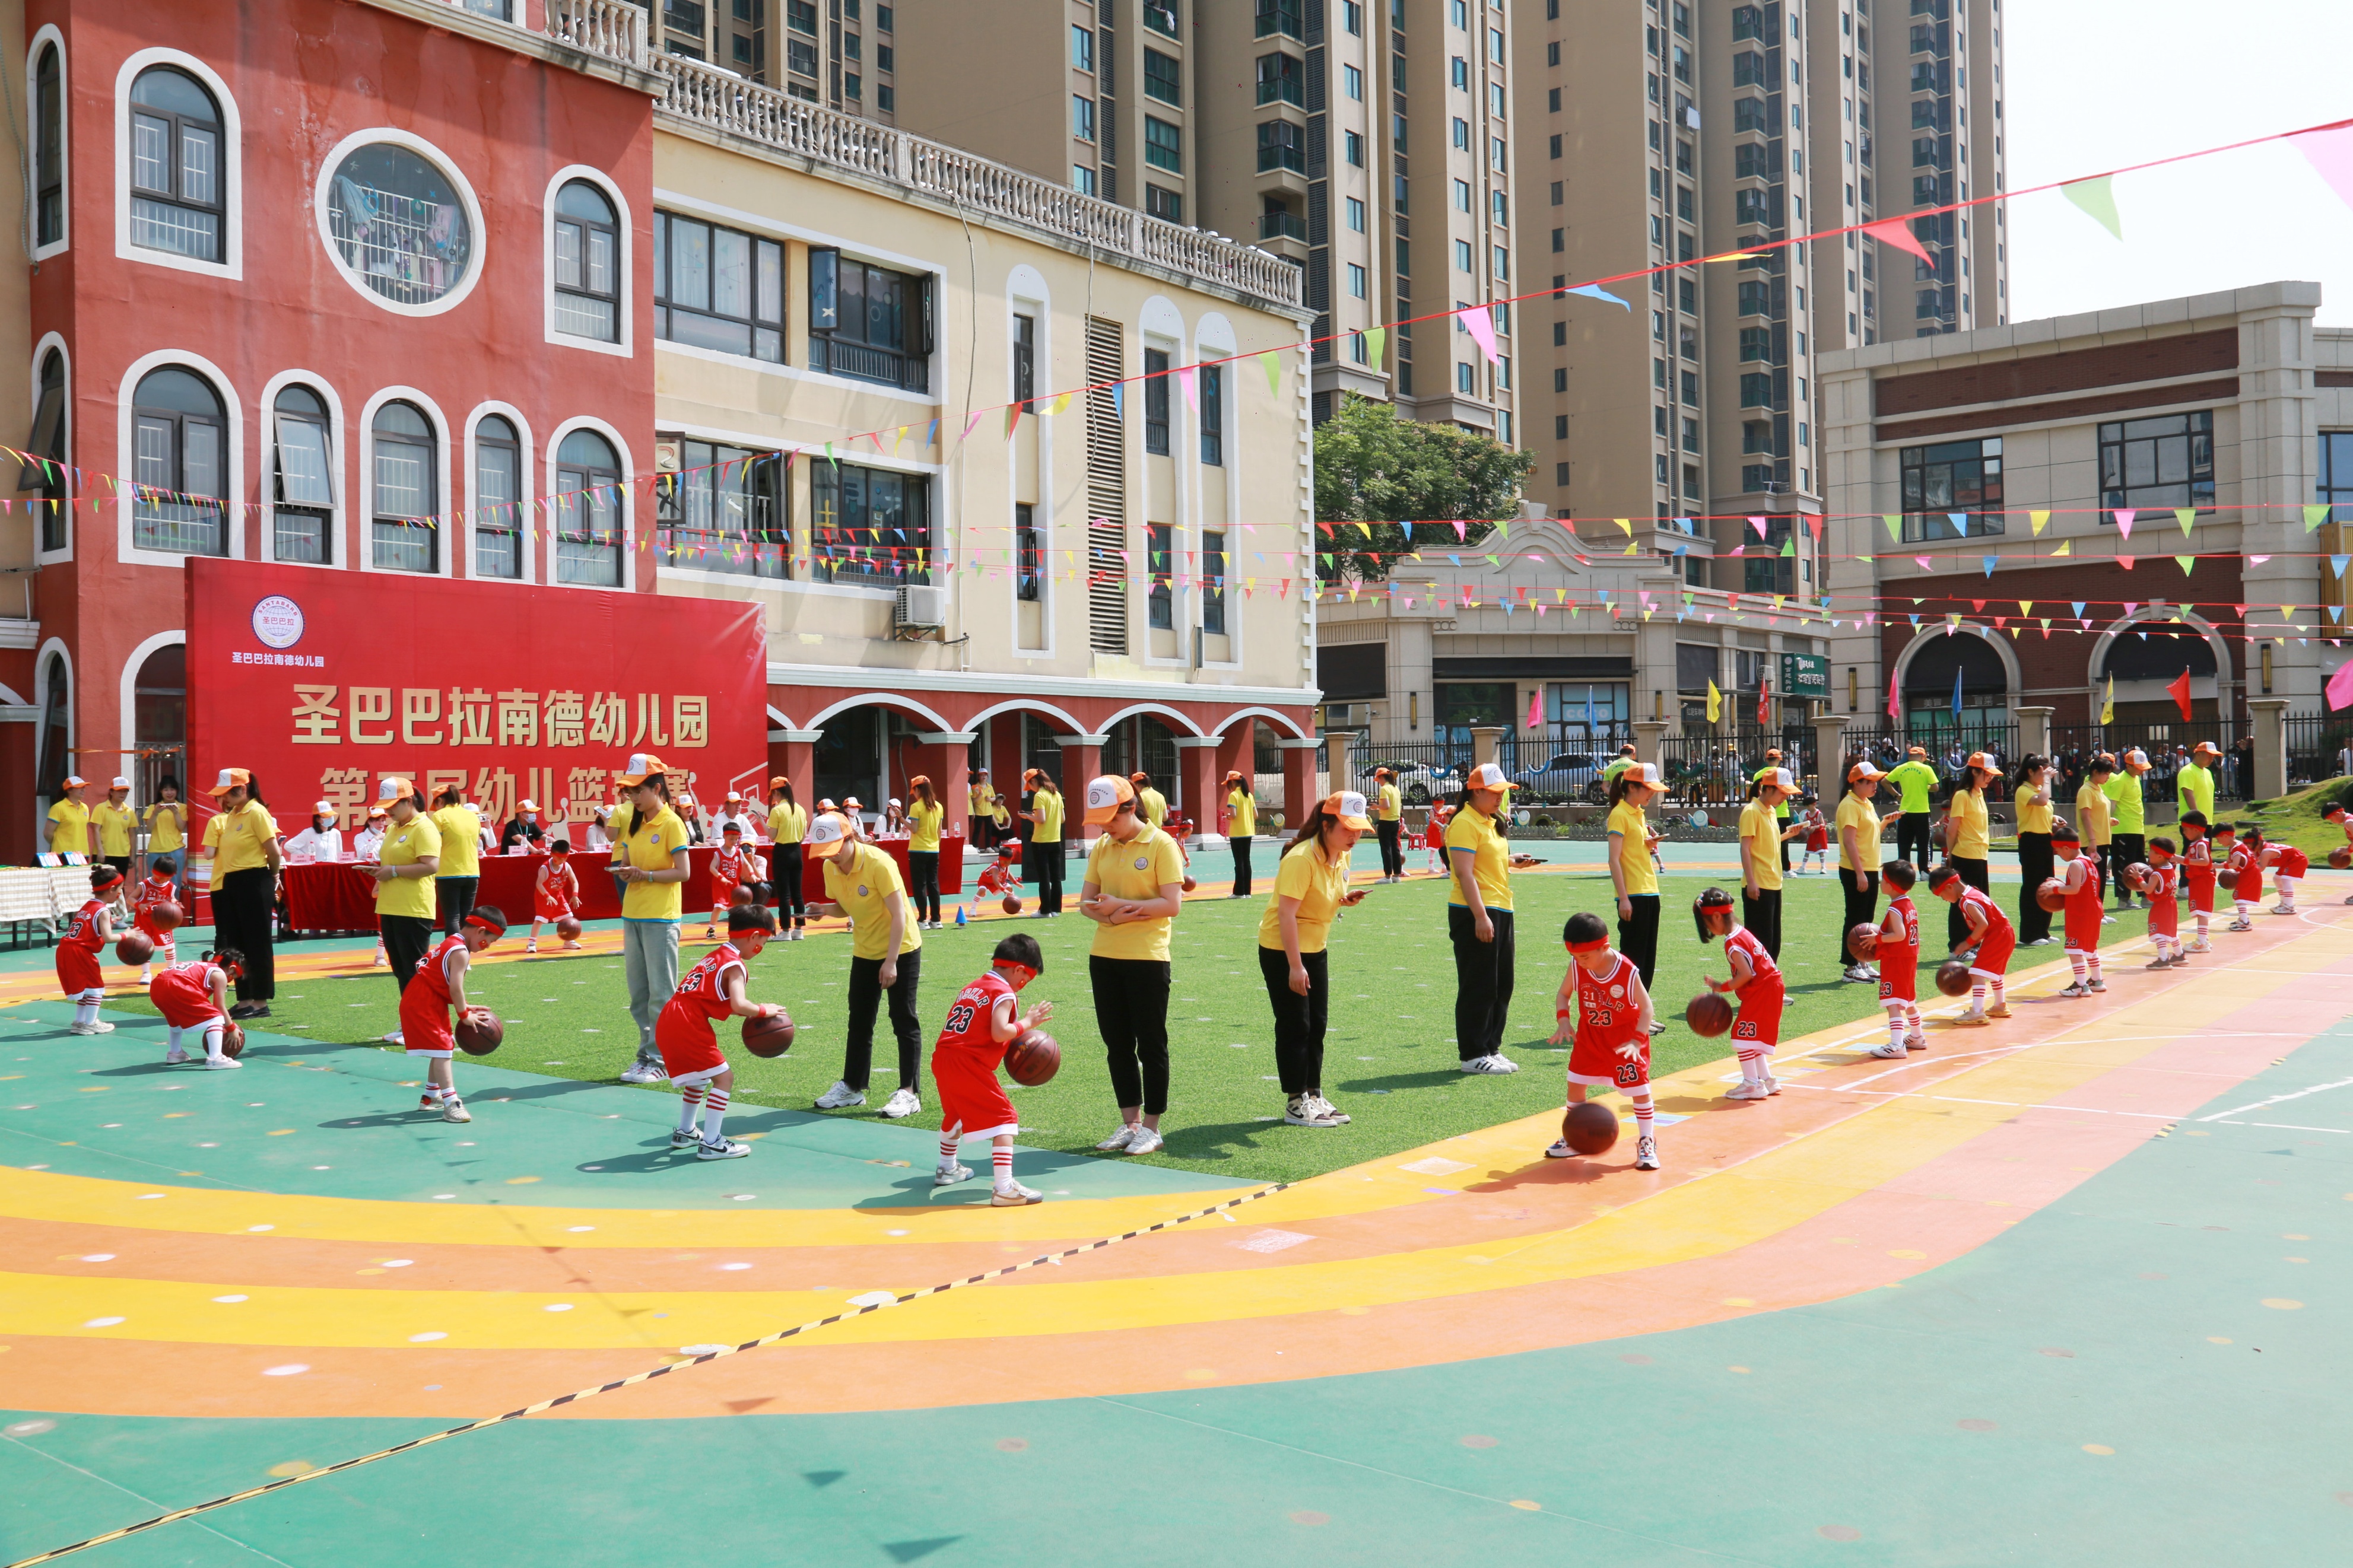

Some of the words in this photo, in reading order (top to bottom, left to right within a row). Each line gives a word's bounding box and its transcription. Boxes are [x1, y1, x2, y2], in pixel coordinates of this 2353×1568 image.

[262, 616, 294, 626] 圣巴巴拉
[232, 651, 324, 667] 圣巴巴拉南德幼儿园
[291, 684, 709, 748] 圣巴巴拉南德幼儿园
[1583, 991, 1595, 1000] 21
[944, 1005, 974, 1034] 23
[1588, 1010, 1612, 1026] 23
[1738, 1021, 1757, 1038] 23
[1617, 1063, 1638, 1084] 23
